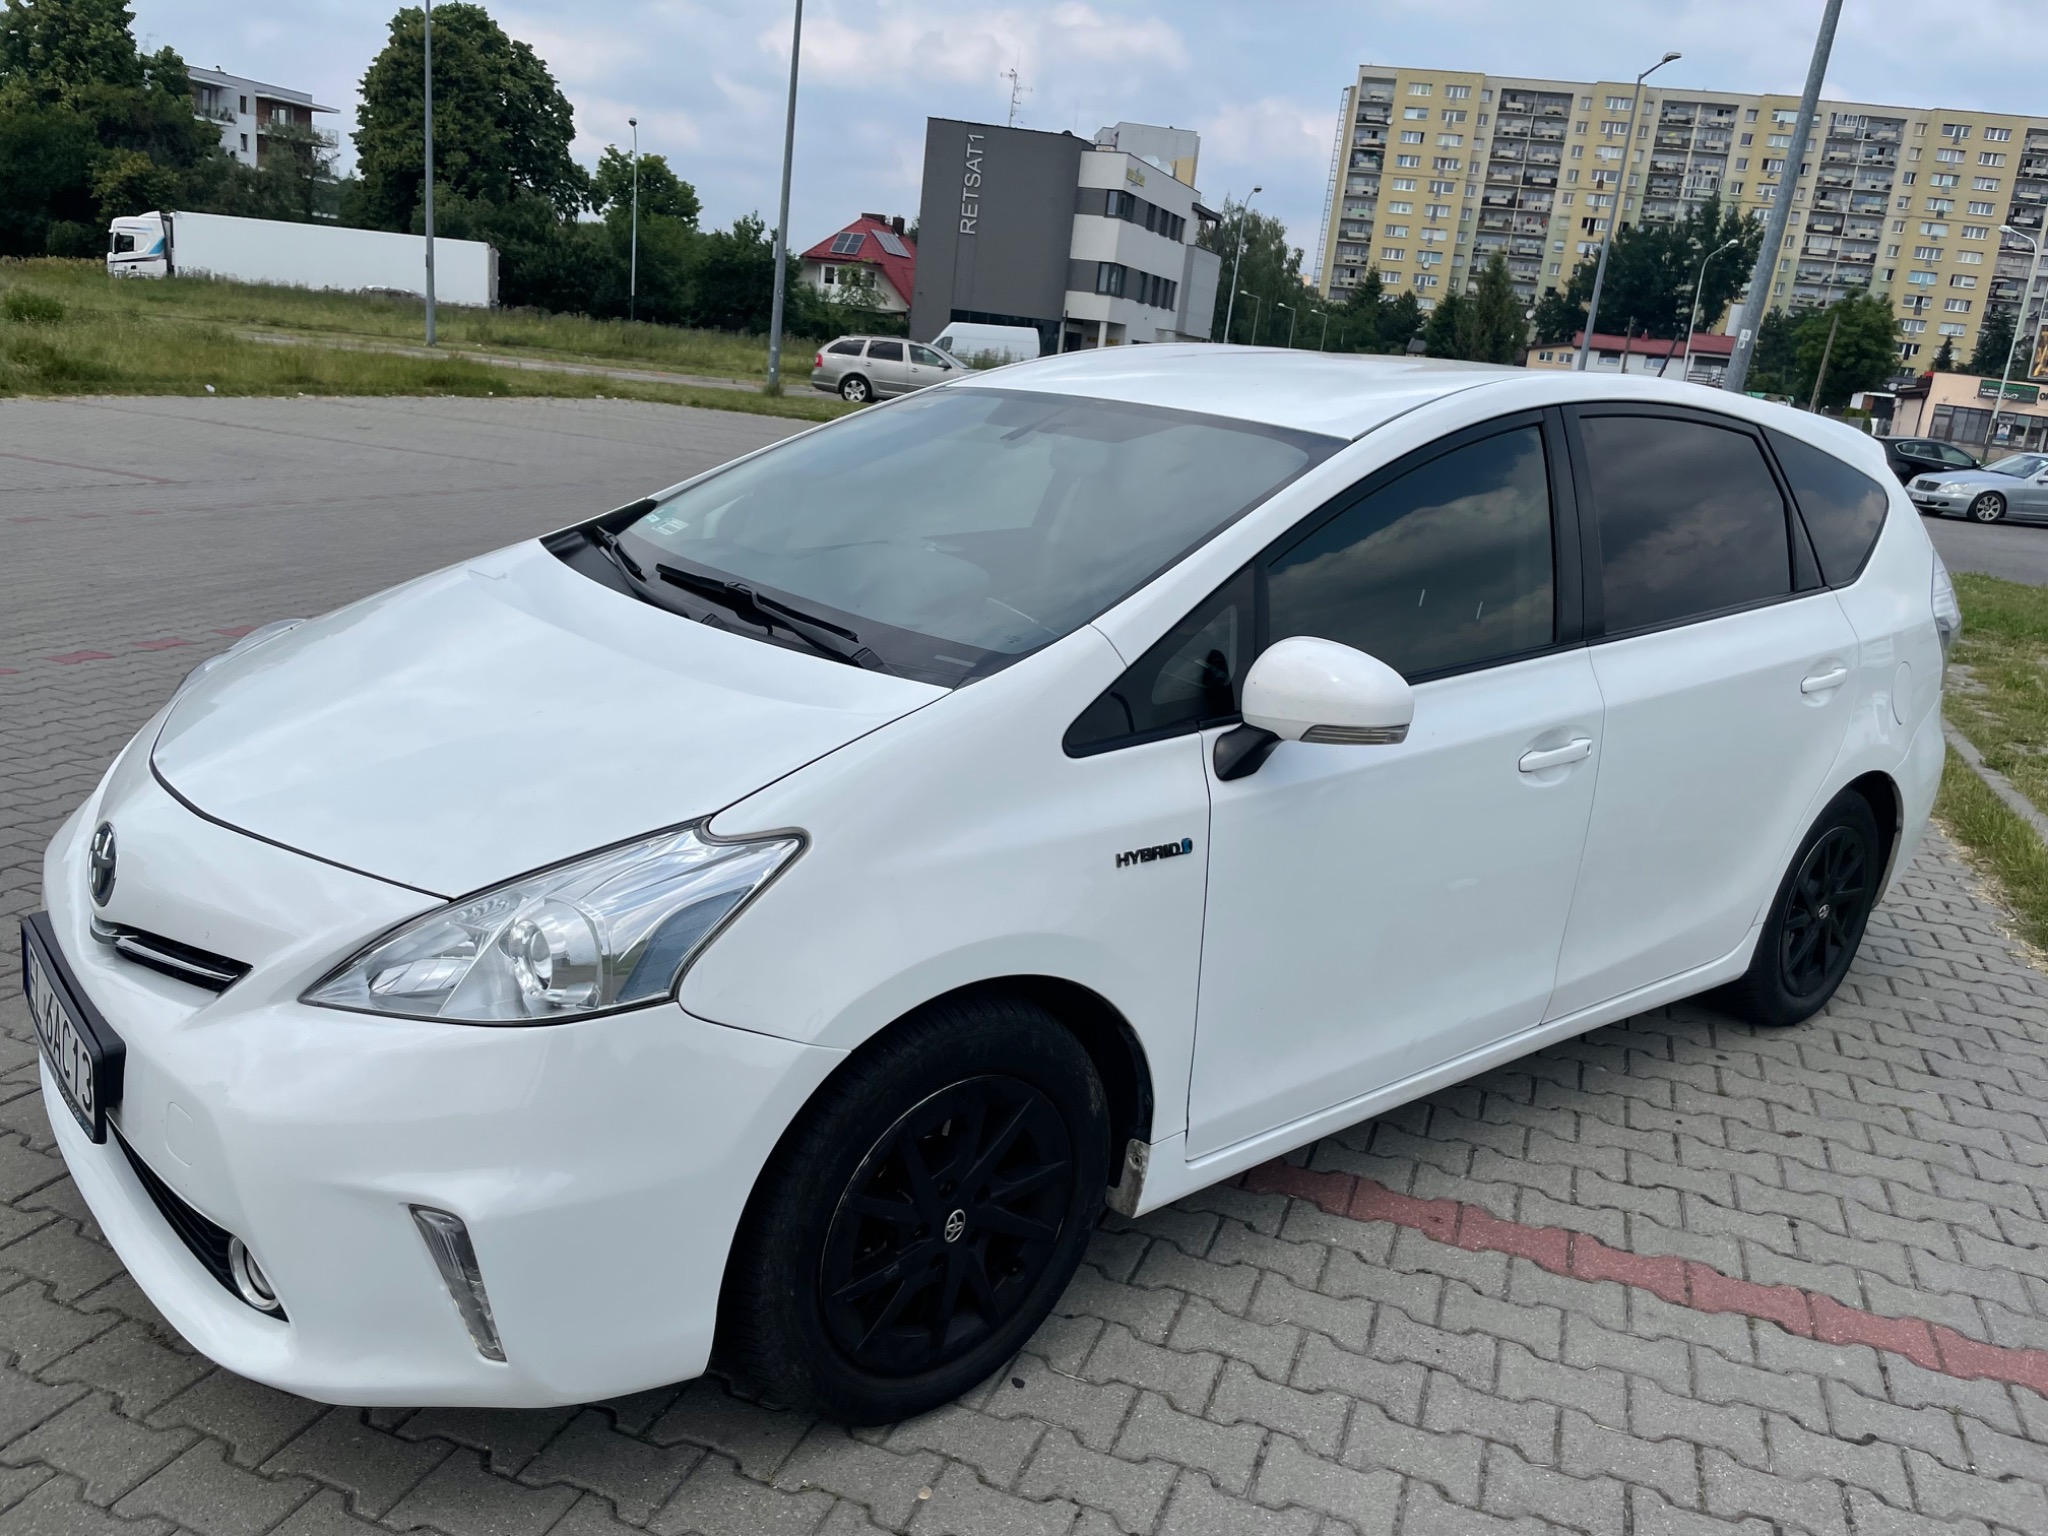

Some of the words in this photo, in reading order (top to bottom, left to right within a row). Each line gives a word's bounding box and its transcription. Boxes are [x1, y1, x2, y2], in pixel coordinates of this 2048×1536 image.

[960, 133, 985, 235] RETSAT1
[1115, 841, 1181, 868] HYBRID
[46, 991, 93, 1112] 6AC13
